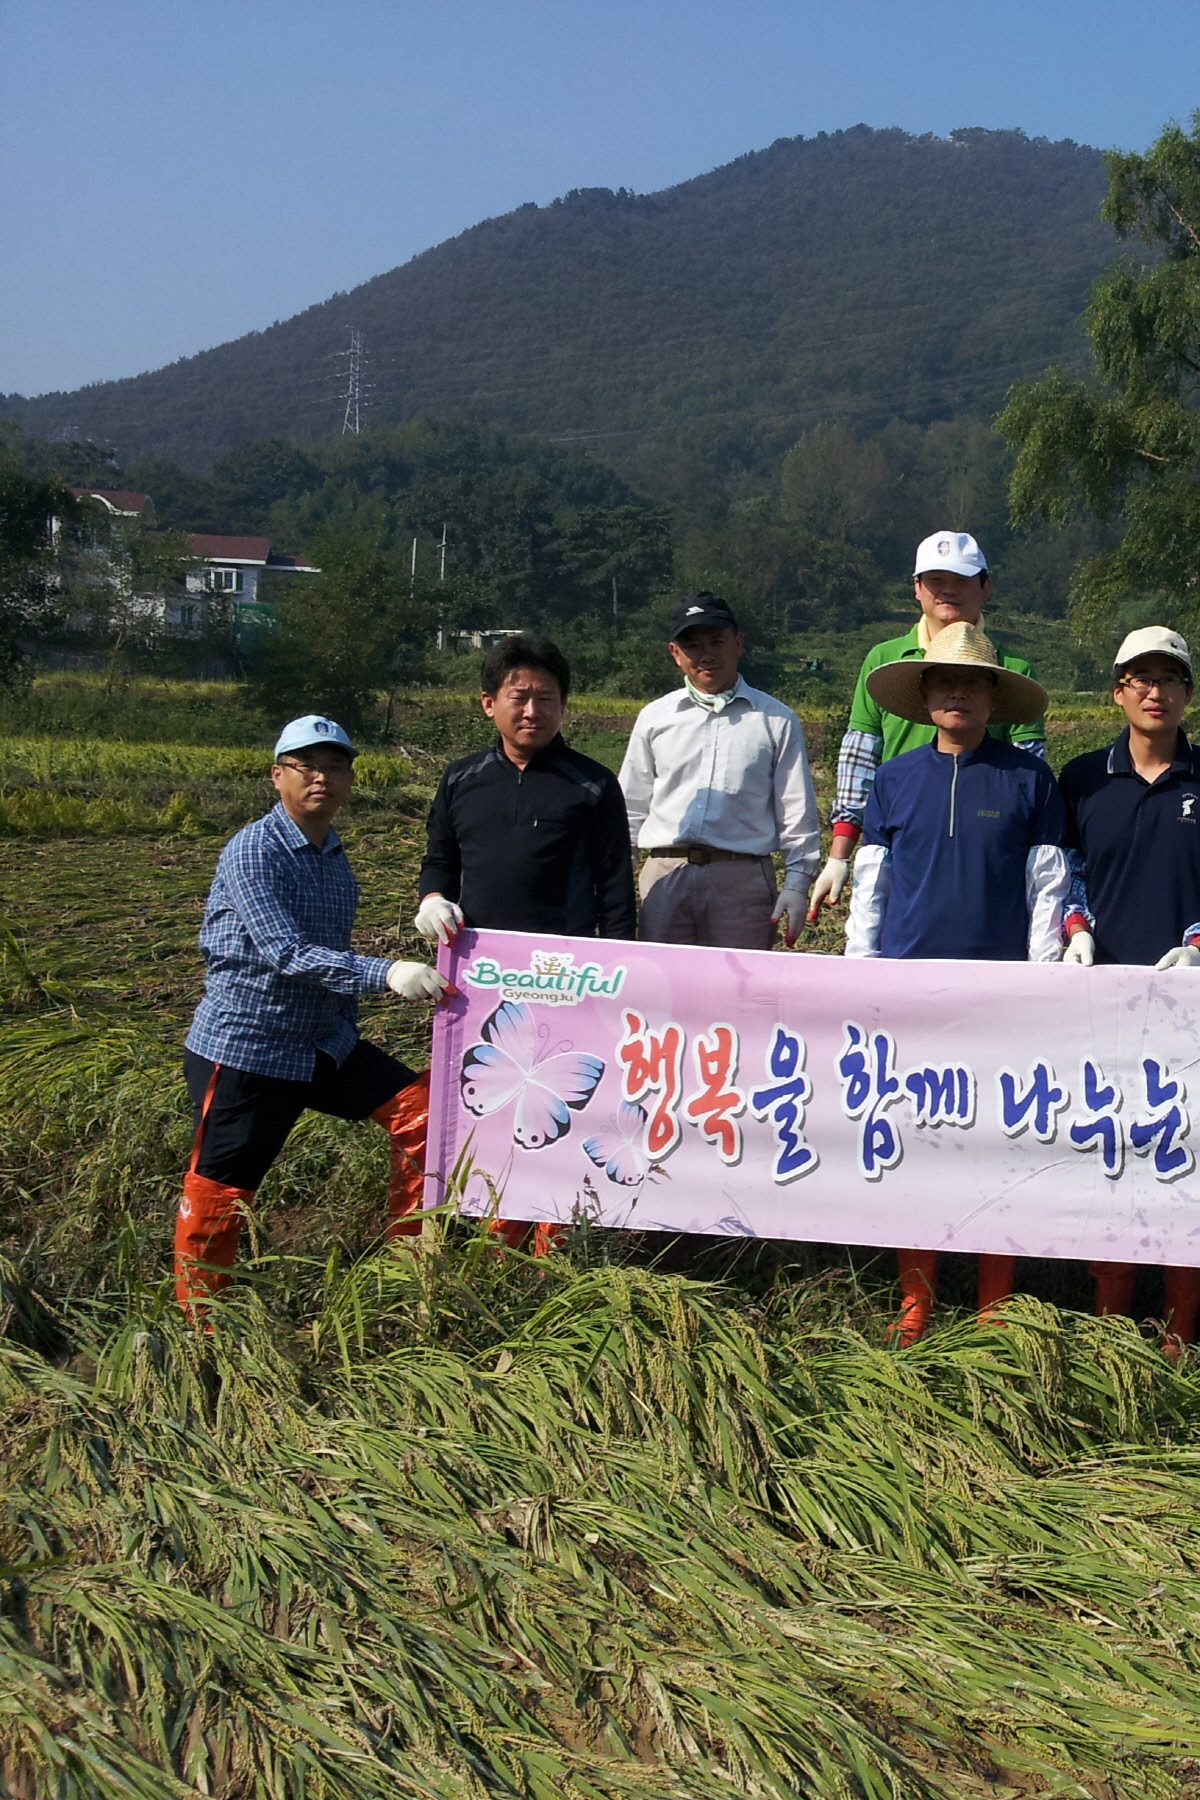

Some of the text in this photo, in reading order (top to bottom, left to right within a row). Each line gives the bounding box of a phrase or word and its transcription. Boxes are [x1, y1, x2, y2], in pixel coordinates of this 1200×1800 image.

[467, 961, 624, 998] Beautiful
[620, 1013, 813, 1176] 행복을
[837, 1025, 969, 1172] 함께
[1000, 1058, 1188, 1174] 나누는
